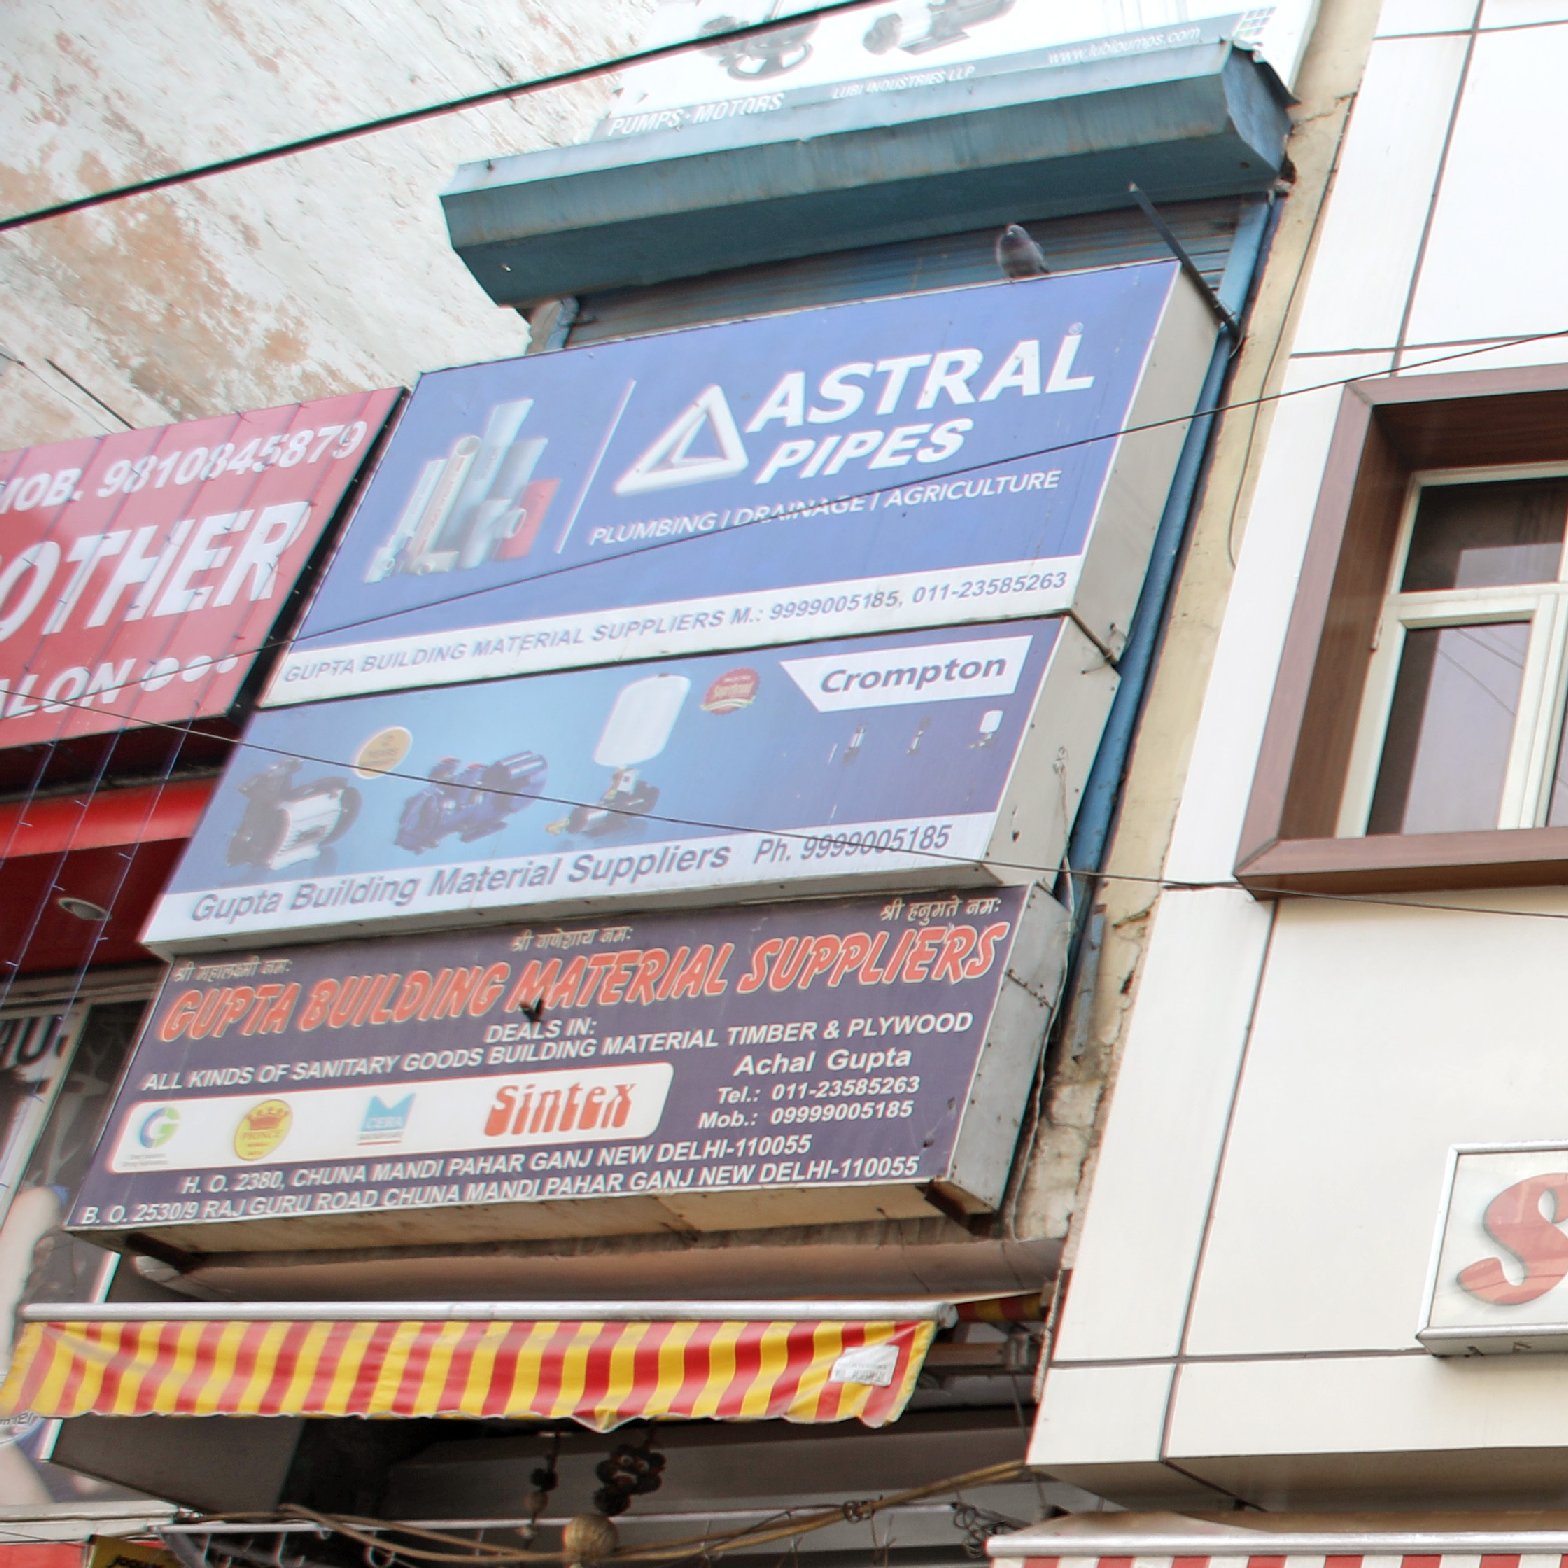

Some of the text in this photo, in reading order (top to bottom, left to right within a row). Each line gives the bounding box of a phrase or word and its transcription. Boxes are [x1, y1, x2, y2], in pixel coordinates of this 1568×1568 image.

[746, 334, 1095, 432] ASTRAL
[98, 421, 367, 497] 9810845879
[755, 418, 973, 484] PIPES
[588, 470, 1062, 546] PLUMBING DRAINAGE AGRICULTURE
[284, 658, 355, 683] GUPTA
[360, 644, 466, 672] BUILDING
[471, 628, 585, 657] MATERIAL
[592, 608, 725, 641] SUPPLIERS
[913, 572, 1068, 603] 011-23585263
[820, 657, 1007, 695] Crompton
[192, 824, 952, 925] Gupta Building Material Suppliers Ph. 9999005185
[159, 981, 301, 1043] GUPTA
[299, 960, 511, 1032] BUILDING
[503, 942, 735, 1012] MATERIAL
[736, 921, 1010, 995] SUPPLIERS
[142, 1011, 974, 1092] ALL KINDS OF SANITARY GOODS BUILDING MATERIAL TIMBER & PLYWOOD
[484, 1017, 597, 1044] DEALS IN:
[733, 1047, 912, 1078] Achal Gupta
[484, 1082, 638, 1138] Sintex
[698, 1100, 913, 1131] Mob.: 09999005185
[718, 1076, 920, 1106] Tel.: 011-23585263
[292, 1164, 370, 1189] CHUNA
[374, 1159, 443, 1183] MANDI
[447, 1153, 526, 1177] PAHAR
[531, 1147, 593, 1171] GANJ
[598, 1143, 654, 1168] NEW
[659, 1134, 812, 1162] DELHI-110055
